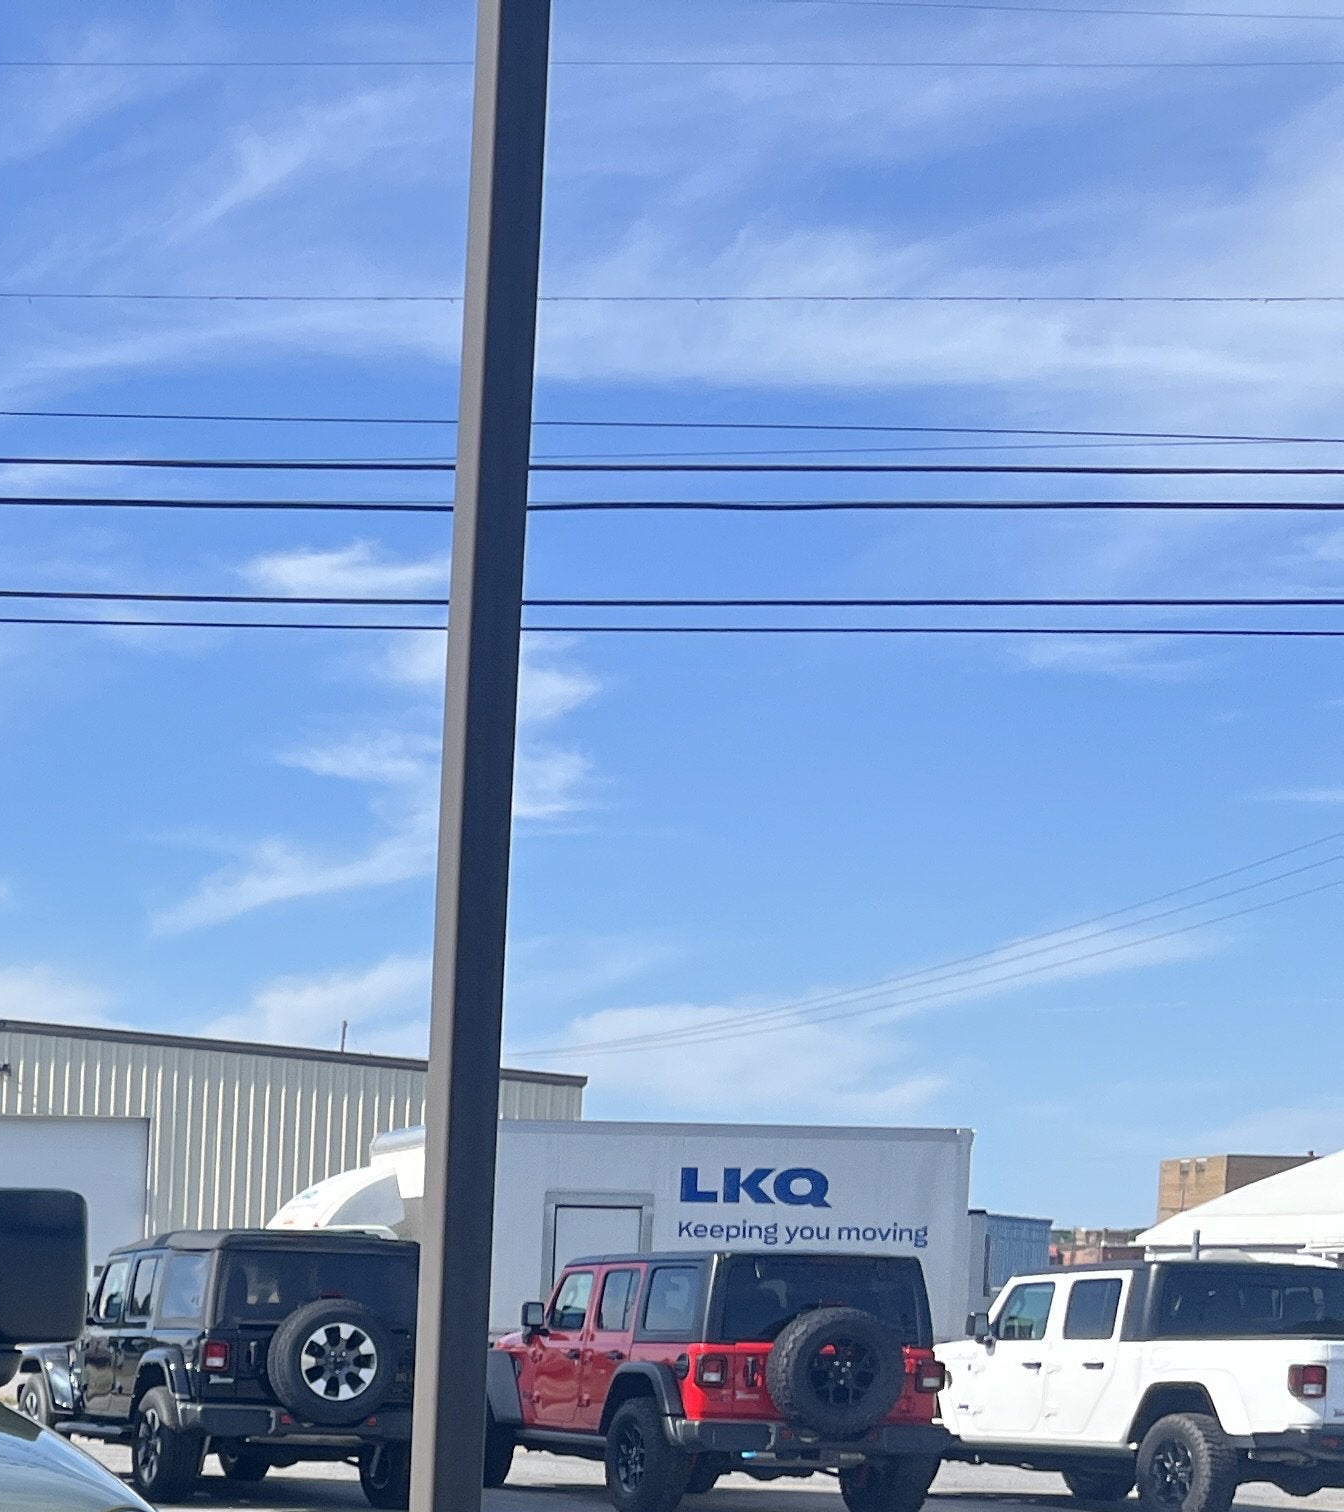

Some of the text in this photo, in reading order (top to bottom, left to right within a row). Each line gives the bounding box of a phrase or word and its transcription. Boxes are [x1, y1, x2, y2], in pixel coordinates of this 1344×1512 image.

[679, 1167, 832, 1208] LKQ
[678, 1220, 929, 1249] Keeping you moving
